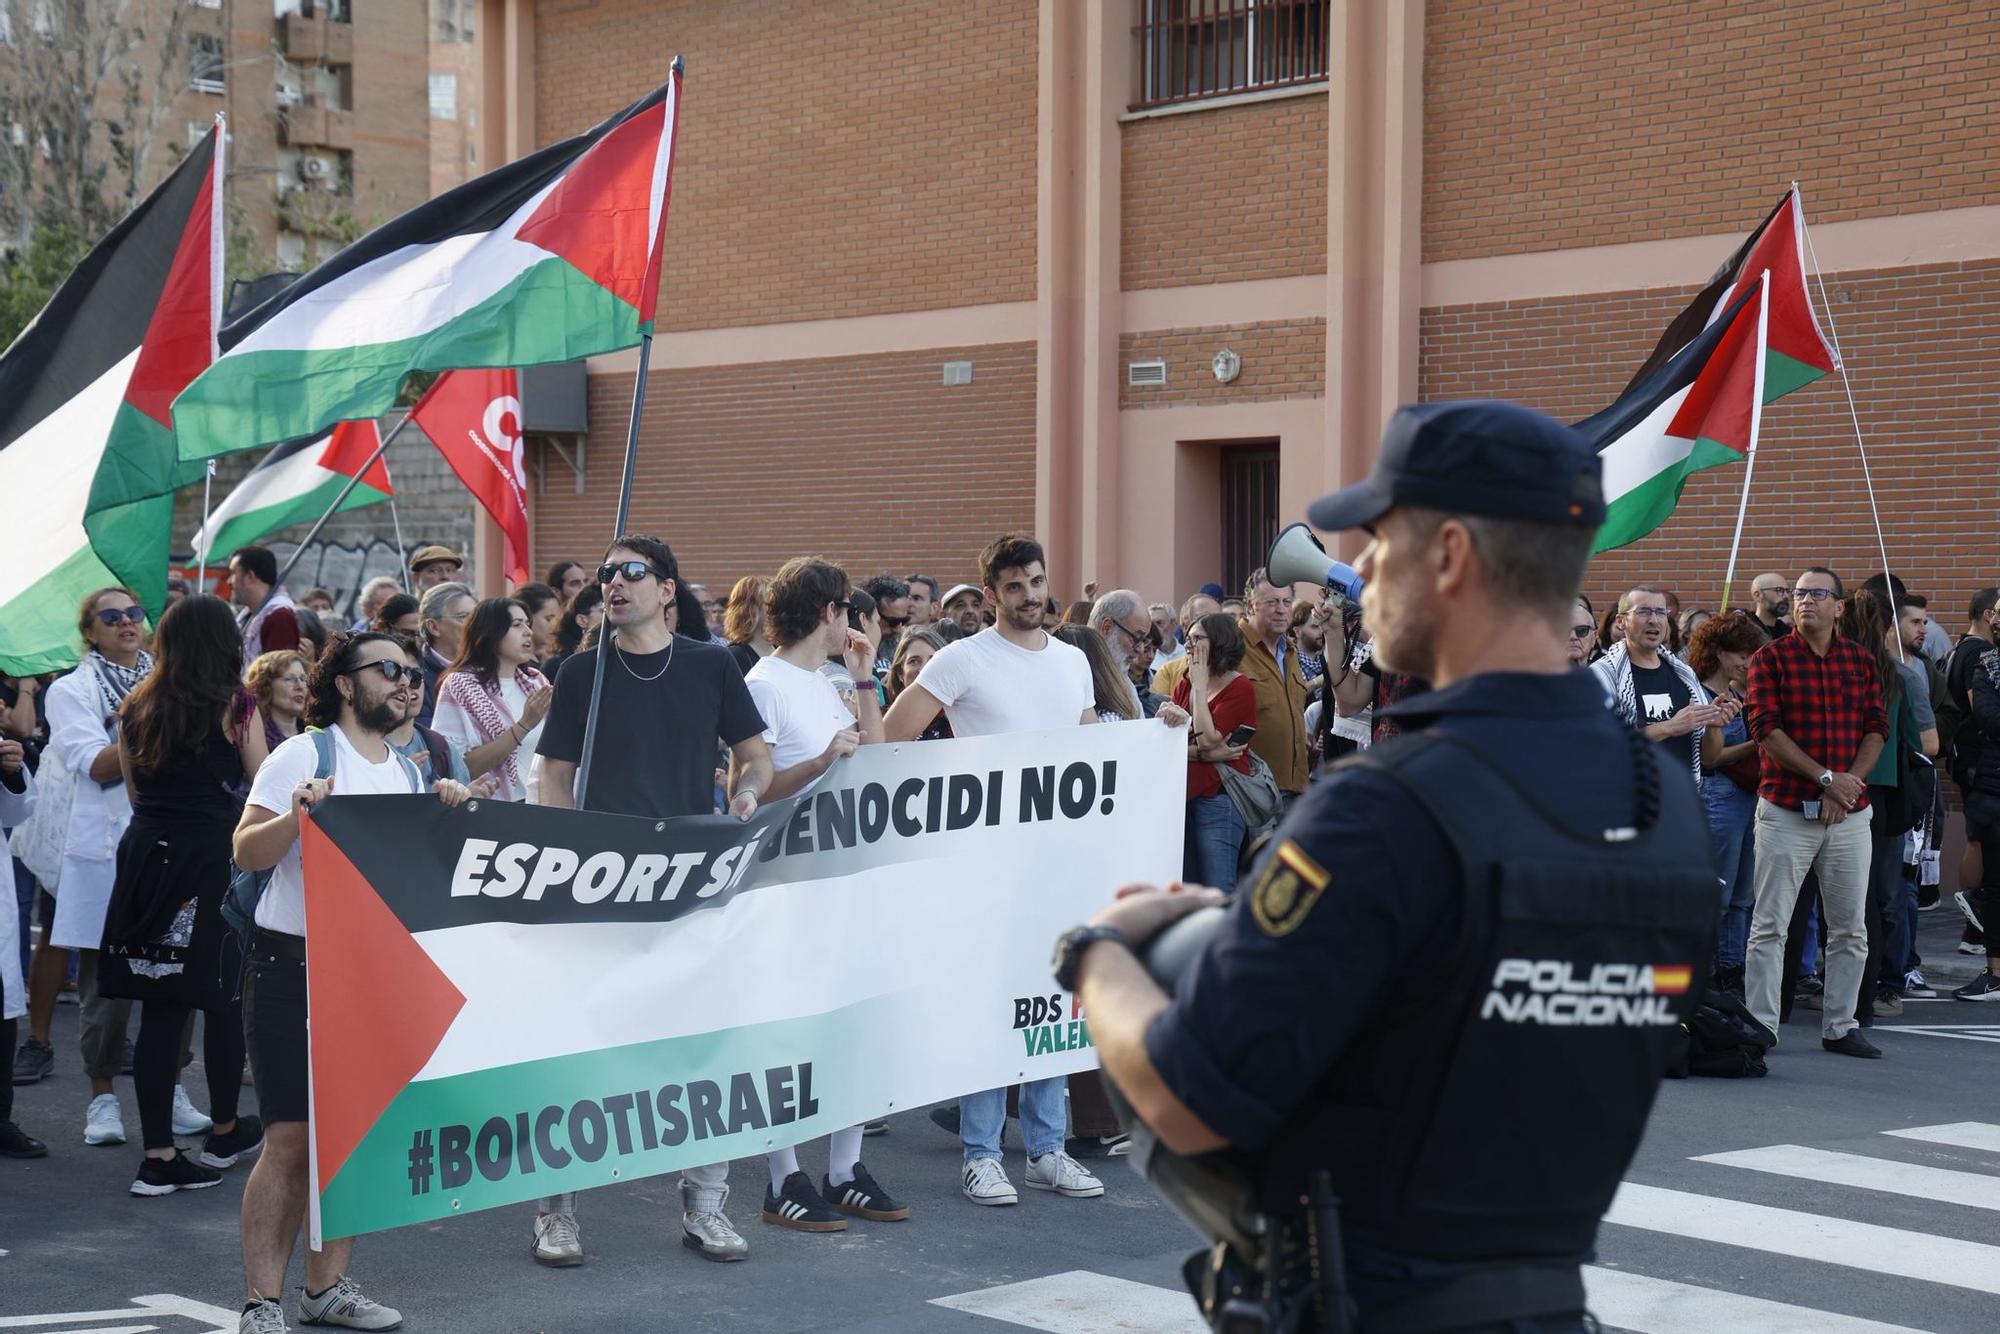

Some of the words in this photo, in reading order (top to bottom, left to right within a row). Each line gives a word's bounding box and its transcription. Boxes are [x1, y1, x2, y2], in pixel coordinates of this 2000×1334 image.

[451, 838, 707, 904] ESPORT
[696, 825, 769, 899] SÍ
[1019, 760, 1117, 823] NO!
[1492, 958, 1655, 995] POLICIA
[1013, 993, 1062, 1029] BDS
[1480, 990, 1678, 1027] NACIONAL
[408, 1062, 819, 1196] #BOICOTISRAEL
